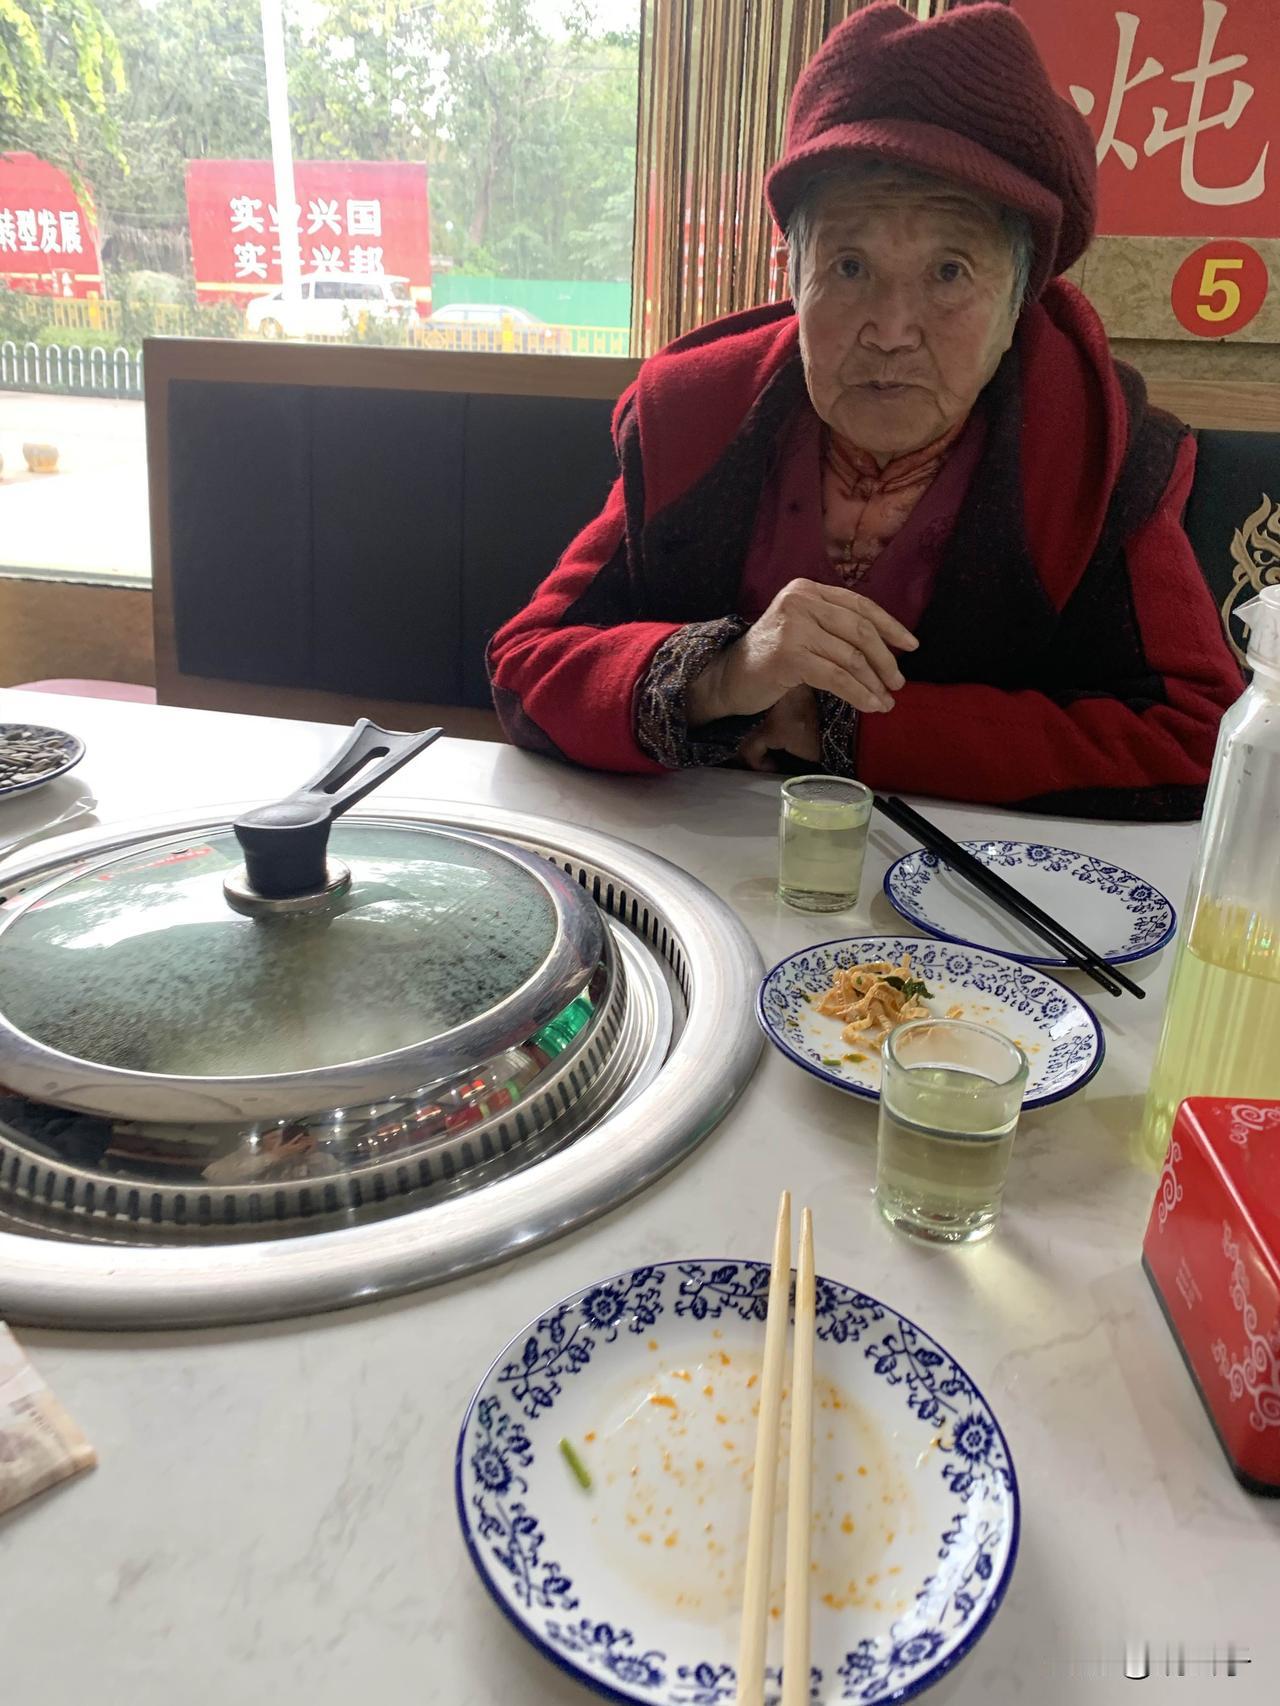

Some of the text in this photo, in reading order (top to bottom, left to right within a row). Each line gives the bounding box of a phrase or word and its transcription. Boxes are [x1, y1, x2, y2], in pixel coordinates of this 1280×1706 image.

[1070, 1, 1270, 206] 炖
[0, 208, 83, 254] 转型发展
[1196, 259, 1243, 321] 5
